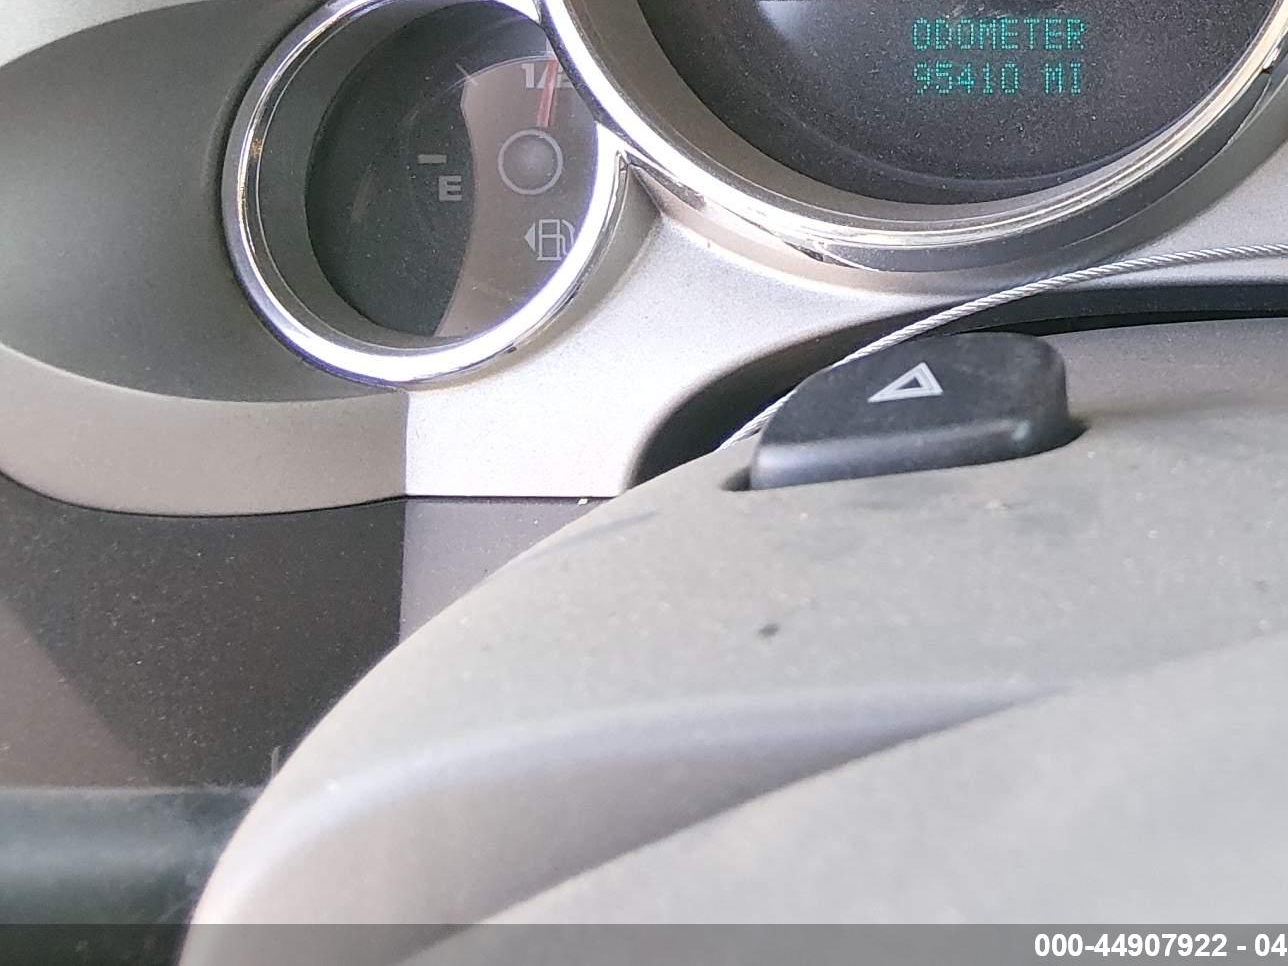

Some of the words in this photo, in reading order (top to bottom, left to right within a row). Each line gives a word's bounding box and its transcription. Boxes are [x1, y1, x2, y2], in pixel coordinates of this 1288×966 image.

[913, 18, 1085, 49] ODOMETER
[912, 64, 1019, 94] 95410
[1043, 64, 1081, 94] MI
[438, 175, 462, 202] E
